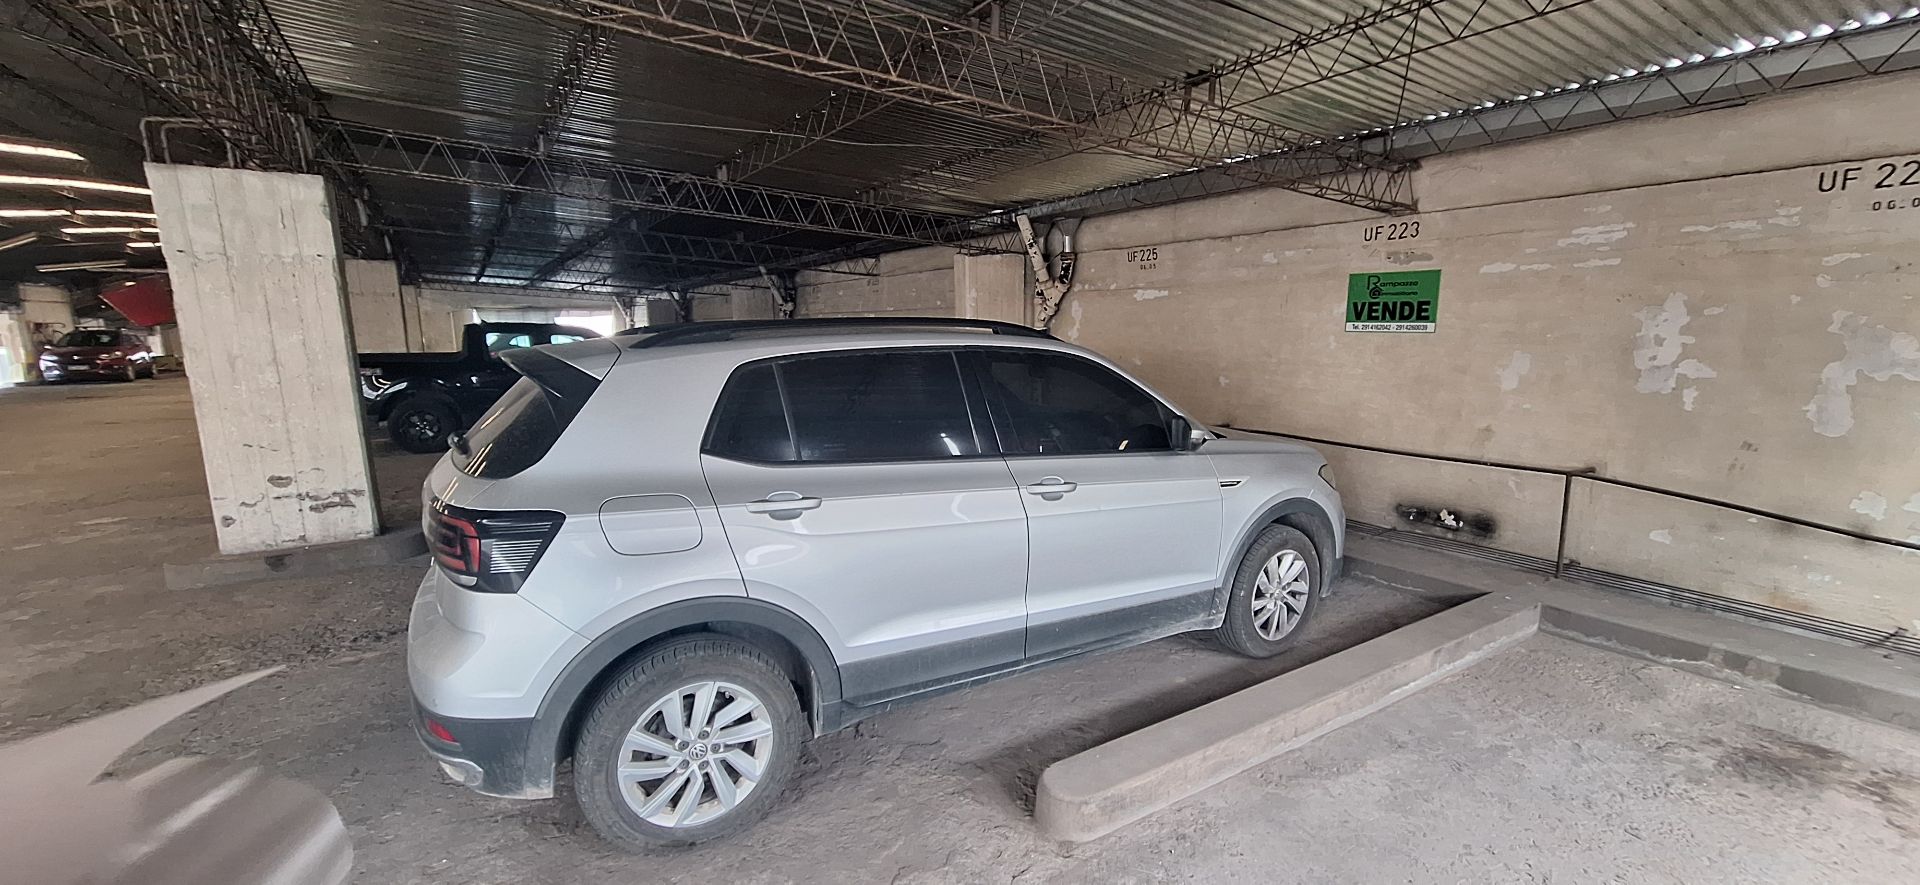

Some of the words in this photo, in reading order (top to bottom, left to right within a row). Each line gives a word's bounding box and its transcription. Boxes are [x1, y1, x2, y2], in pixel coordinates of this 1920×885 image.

[1818, 167, 1862, 192] UF
[1363, 225, 1385, 241] UF
[1387, 221, 1420, 240] 223
[1127, 251, 1138, 262] UF
[1139, 248, 1158, 261] 225
[1352, 300, 1431, 321] VENDE
